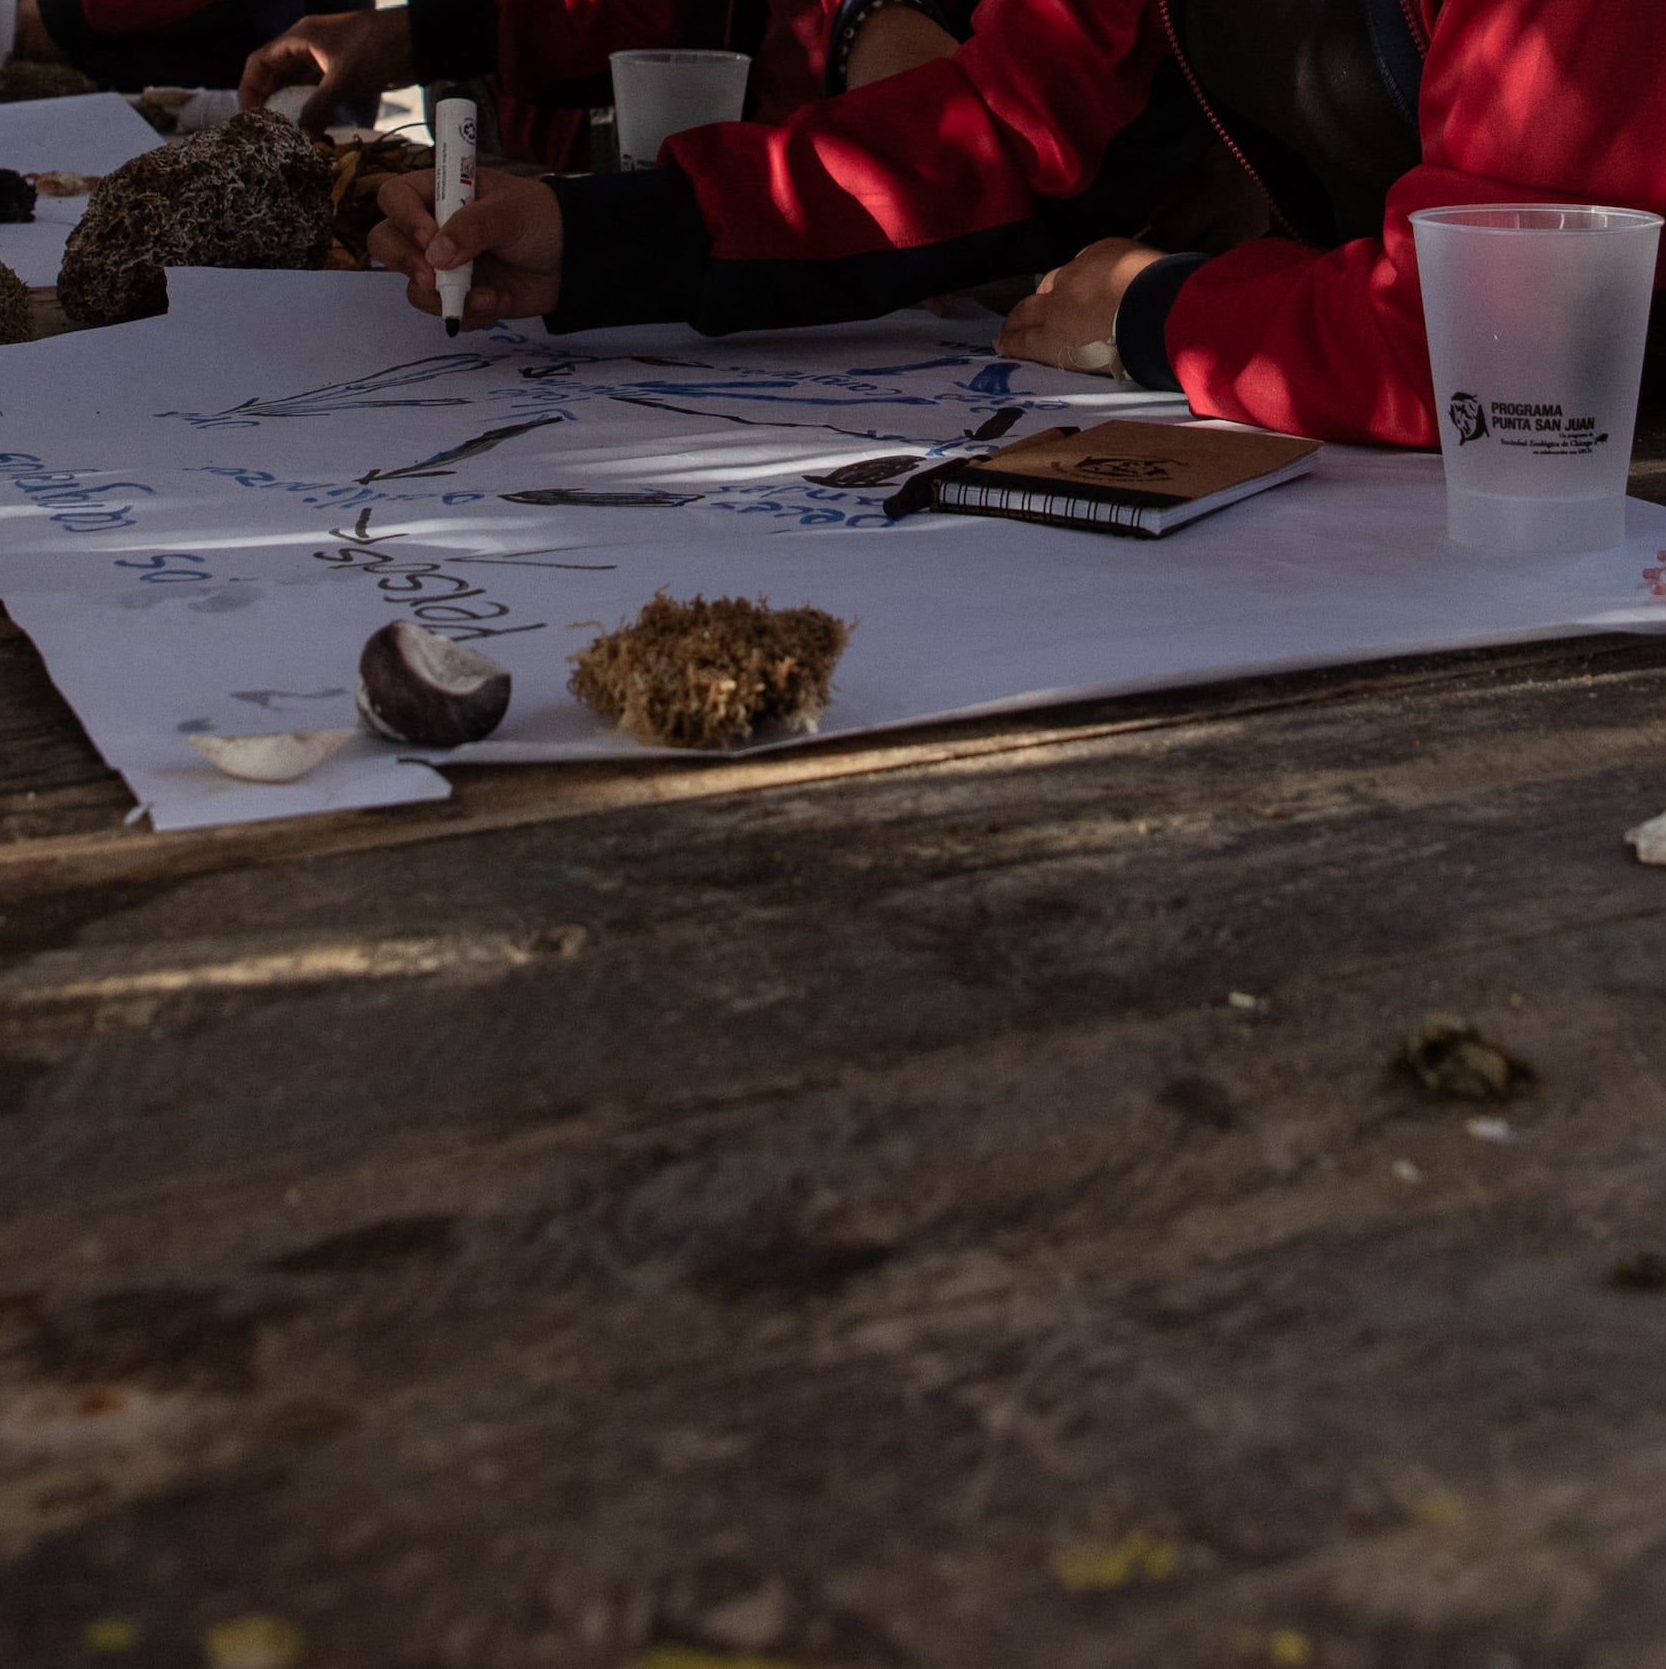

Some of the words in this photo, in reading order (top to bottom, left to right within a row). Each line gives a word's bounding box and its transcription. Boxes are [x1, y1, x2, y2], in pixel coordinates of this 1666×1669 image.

[1491, 401, 1563, 417] PROGRAMA
[1492, 415, 1532, 431] PUNTA
[1535, 417, 1561, 432] SAN
[1564, 416, 1596, 432] JUAN
